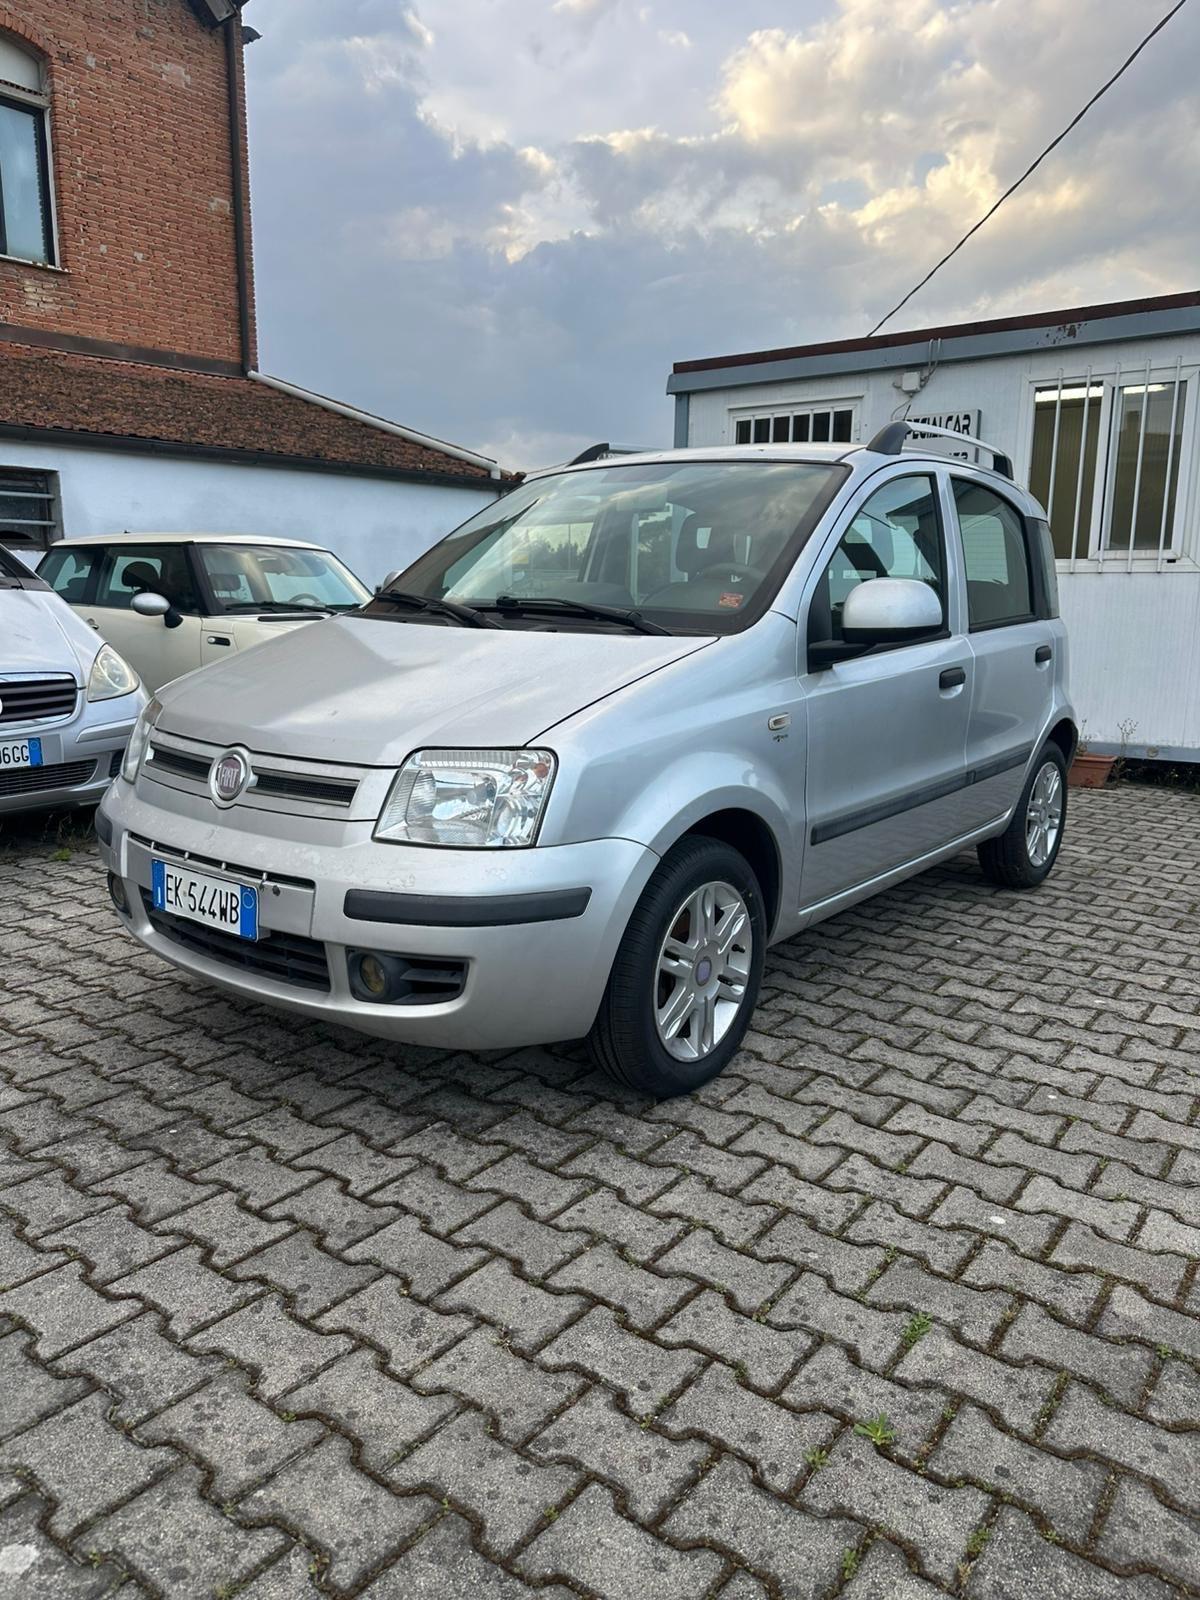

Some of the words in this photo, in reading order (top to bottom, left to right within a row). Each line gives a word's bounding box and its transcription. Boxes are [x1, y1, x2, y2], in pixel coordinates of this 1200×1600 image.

[903, 413, 971, 440] PECIALCAR
[0, 745, 29, 764] 6GG
[220, 766, 240, 788] FIAT
[166, 873, 183, 908] EK
[188, 881, 240, 925] 544WB
